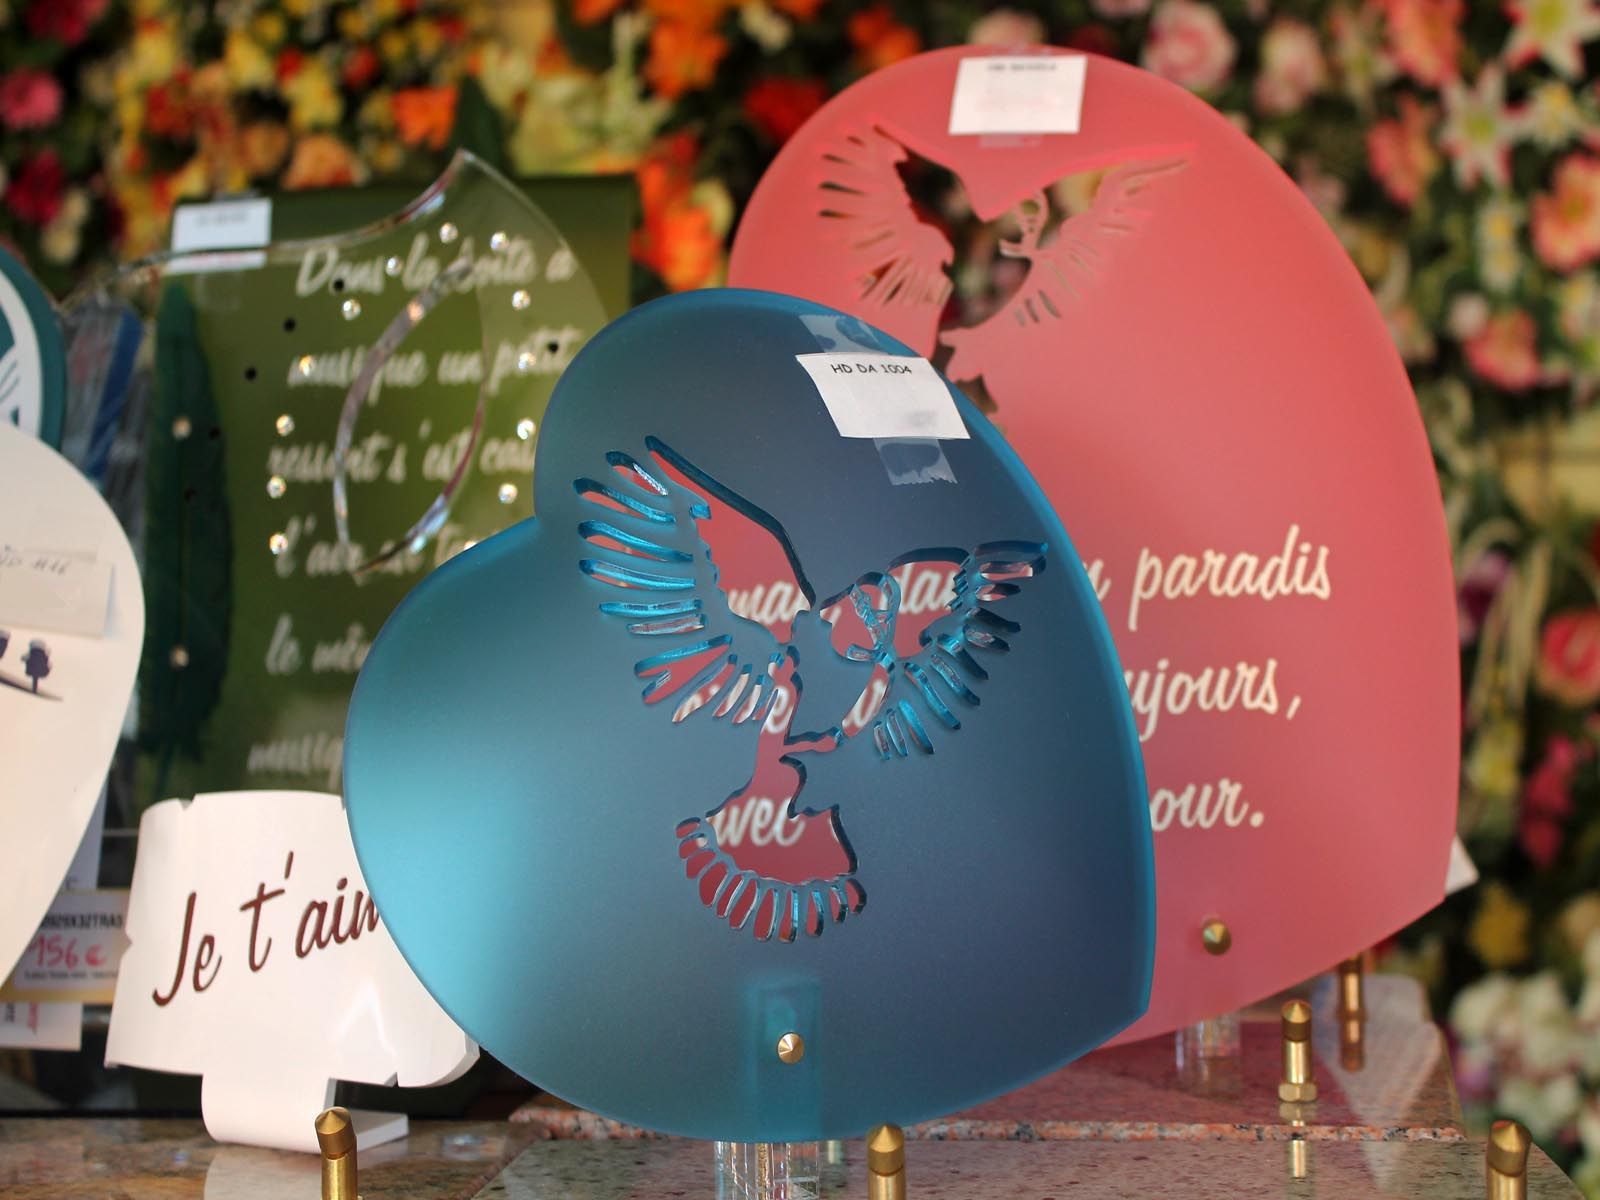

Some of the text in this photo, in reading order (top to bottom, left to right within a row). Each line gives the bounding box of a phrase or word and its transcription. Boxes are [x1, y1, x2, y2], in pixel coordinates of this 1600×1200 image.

[830, 363, 853, 374] HD
[856, 363, 877, 374] DA
[1128, 524, 1331, 632] paradis
[1124, 658, 1301, 743] ujours,
[1149, 778, 1265, 832] our.
[152, 891, 222, 1007] Je
